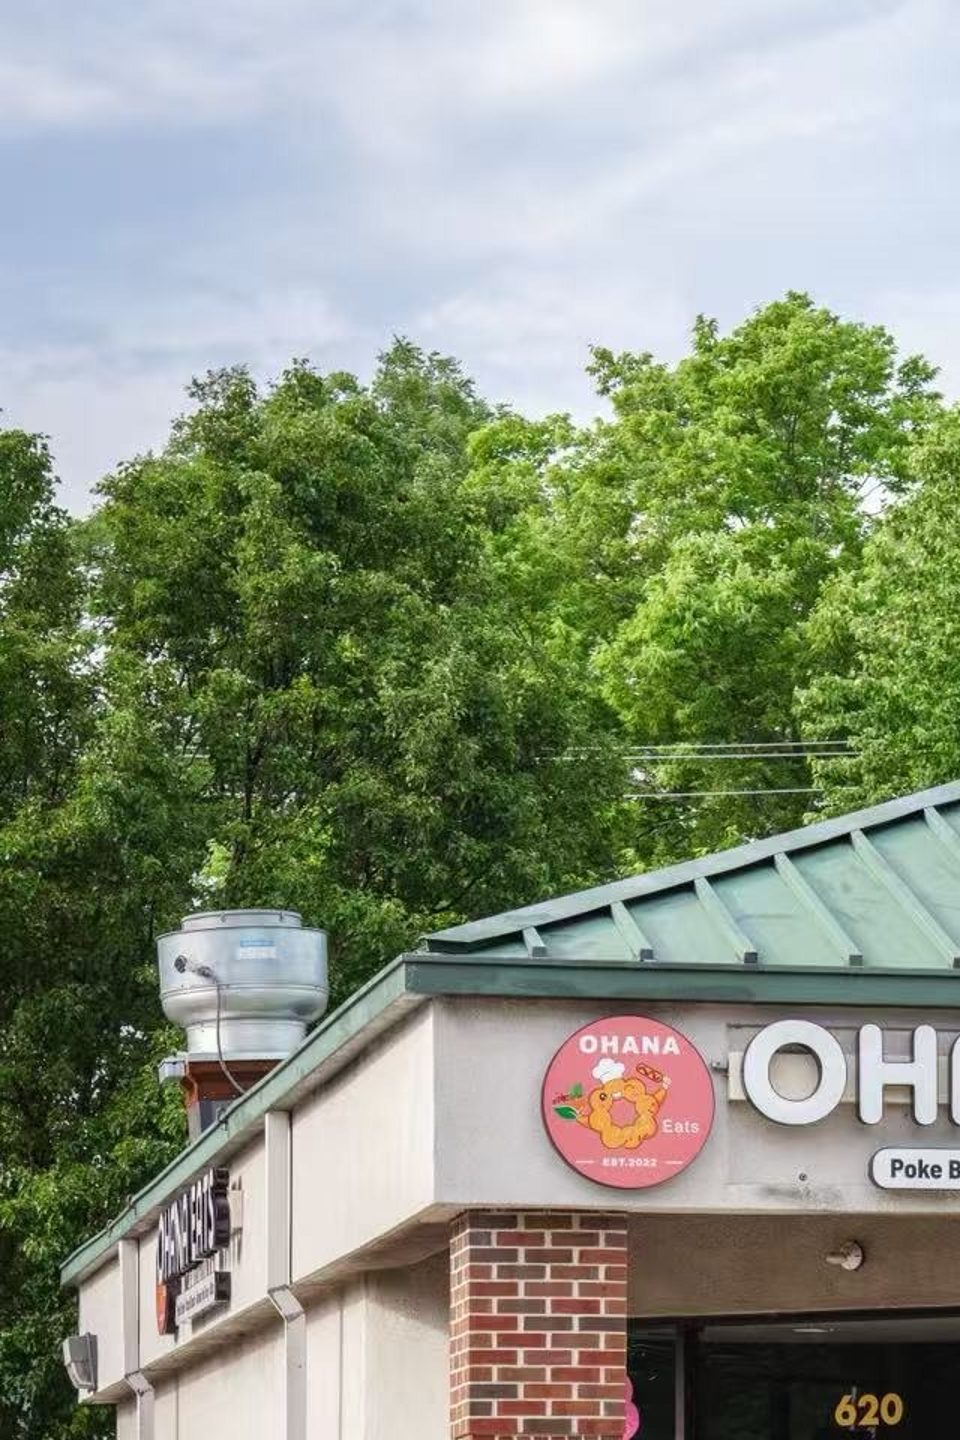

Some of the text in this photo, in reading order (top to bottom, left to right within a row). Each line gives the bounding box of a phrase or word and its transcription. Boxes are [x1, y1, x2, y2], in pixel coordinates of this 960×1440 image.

[579, 1034, 681, 1056] OHANA
[662, 1119, 700, 1134] Eats
[890, 1158, 943, 1179] Poke
[834, 1392, 904, 1427] 620
